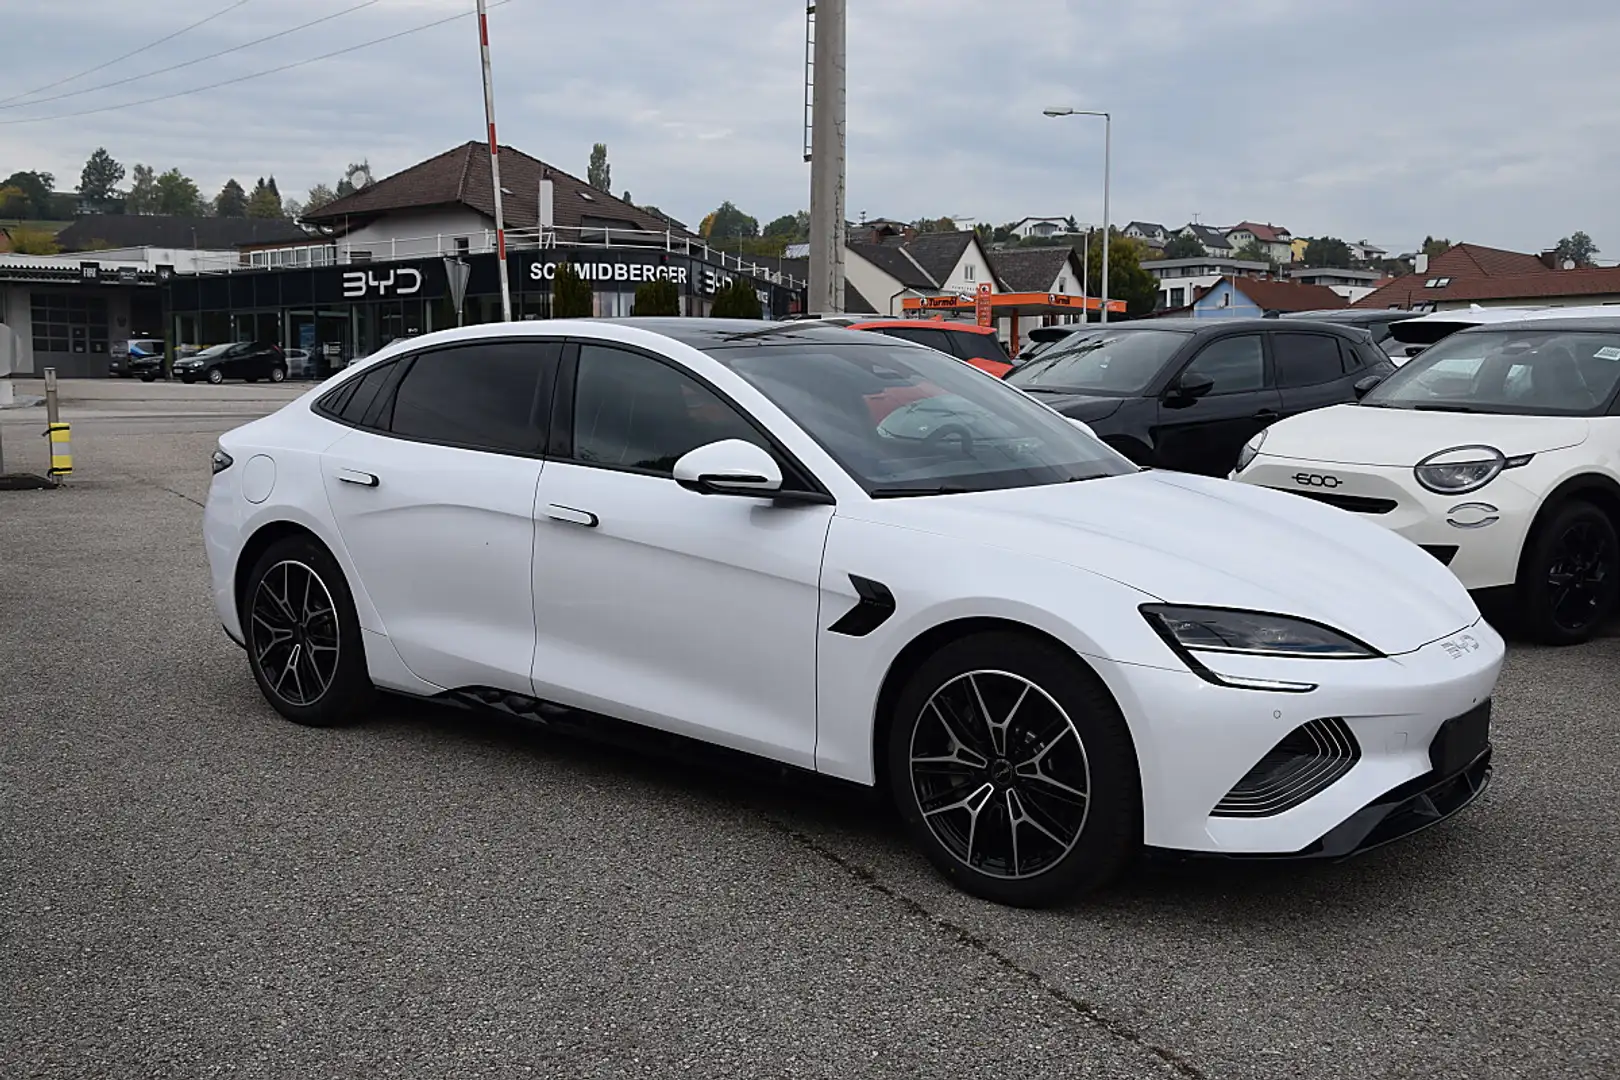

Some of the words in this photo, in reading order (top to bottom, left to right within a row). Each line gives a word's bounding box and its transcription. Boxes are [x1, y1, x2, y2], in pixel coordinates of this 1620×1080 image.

[343, 268, 422, 297] BYD
[530, 262, 688, 284] SCMIDBERGER
[1292, 473, 1342, 488] 600
